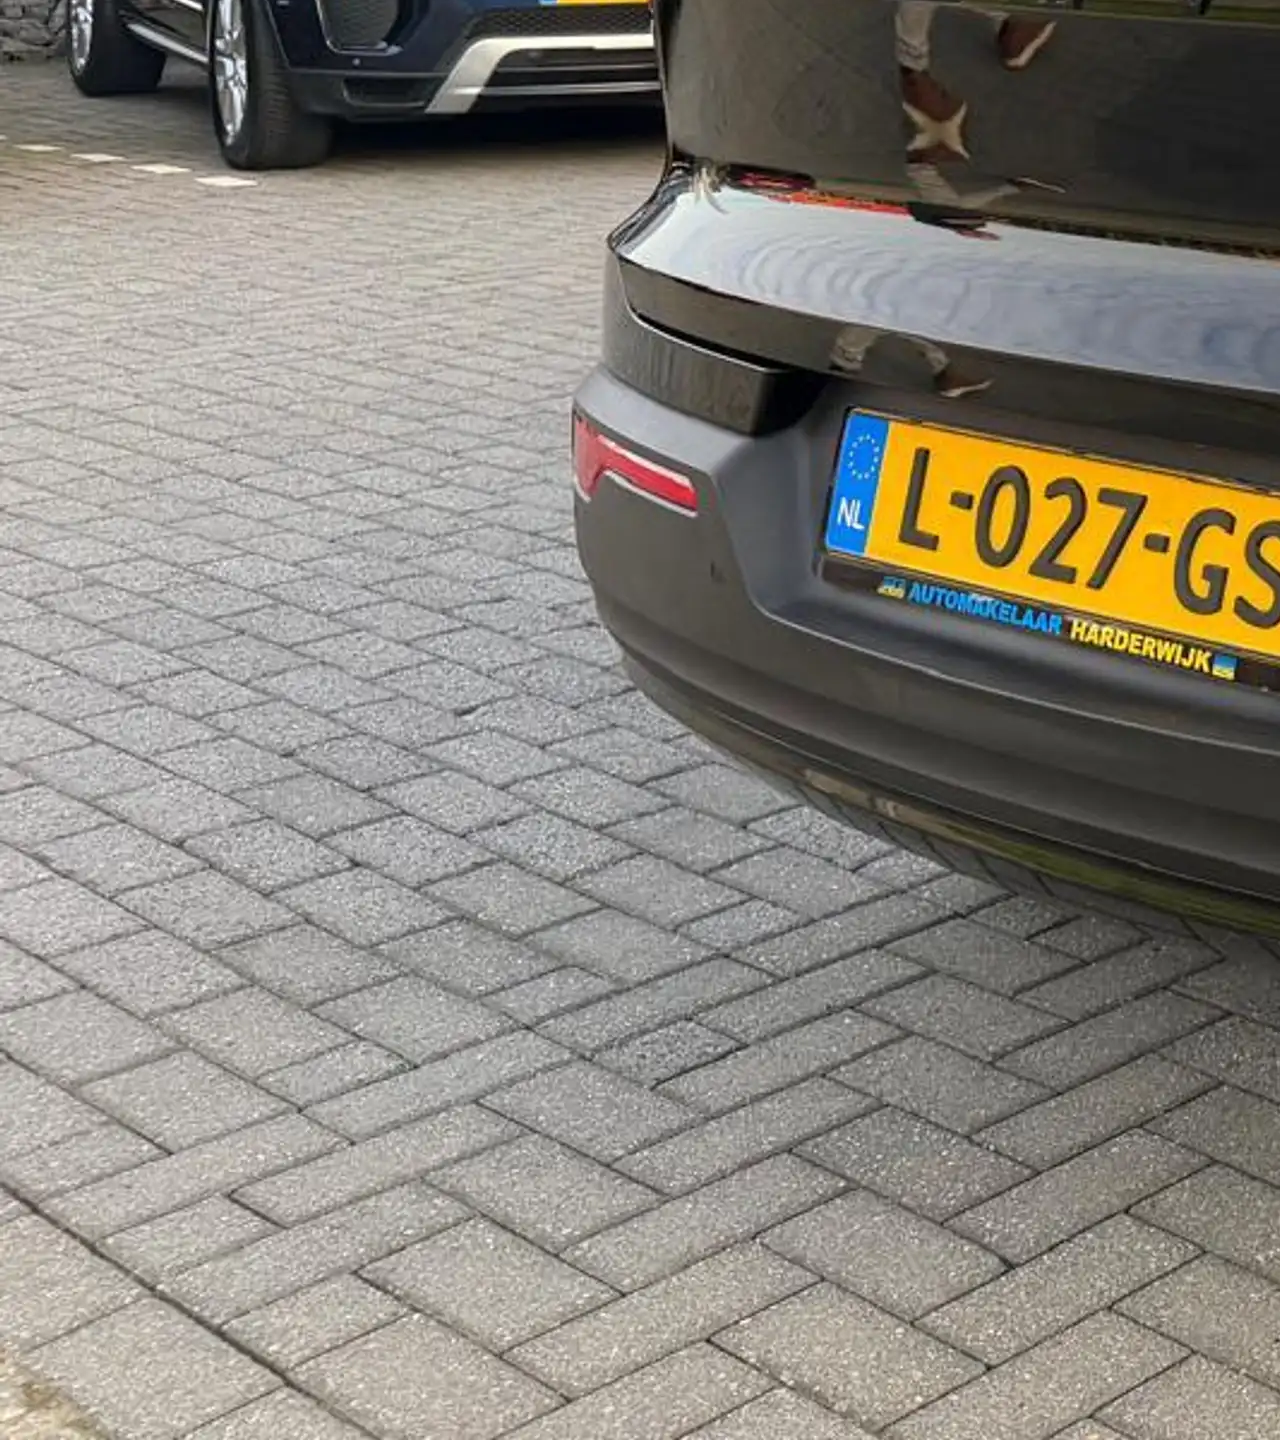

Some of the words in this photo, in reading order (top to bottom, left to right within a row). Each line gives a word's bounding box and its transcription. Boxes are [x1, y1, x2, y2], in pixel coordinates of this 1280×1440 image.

[836, 496, 866, 531] NL
[908, 582, 1062, 636] AUTOMAKELAAR
[1069, 618, 1214, 674] HARDERWIJK
